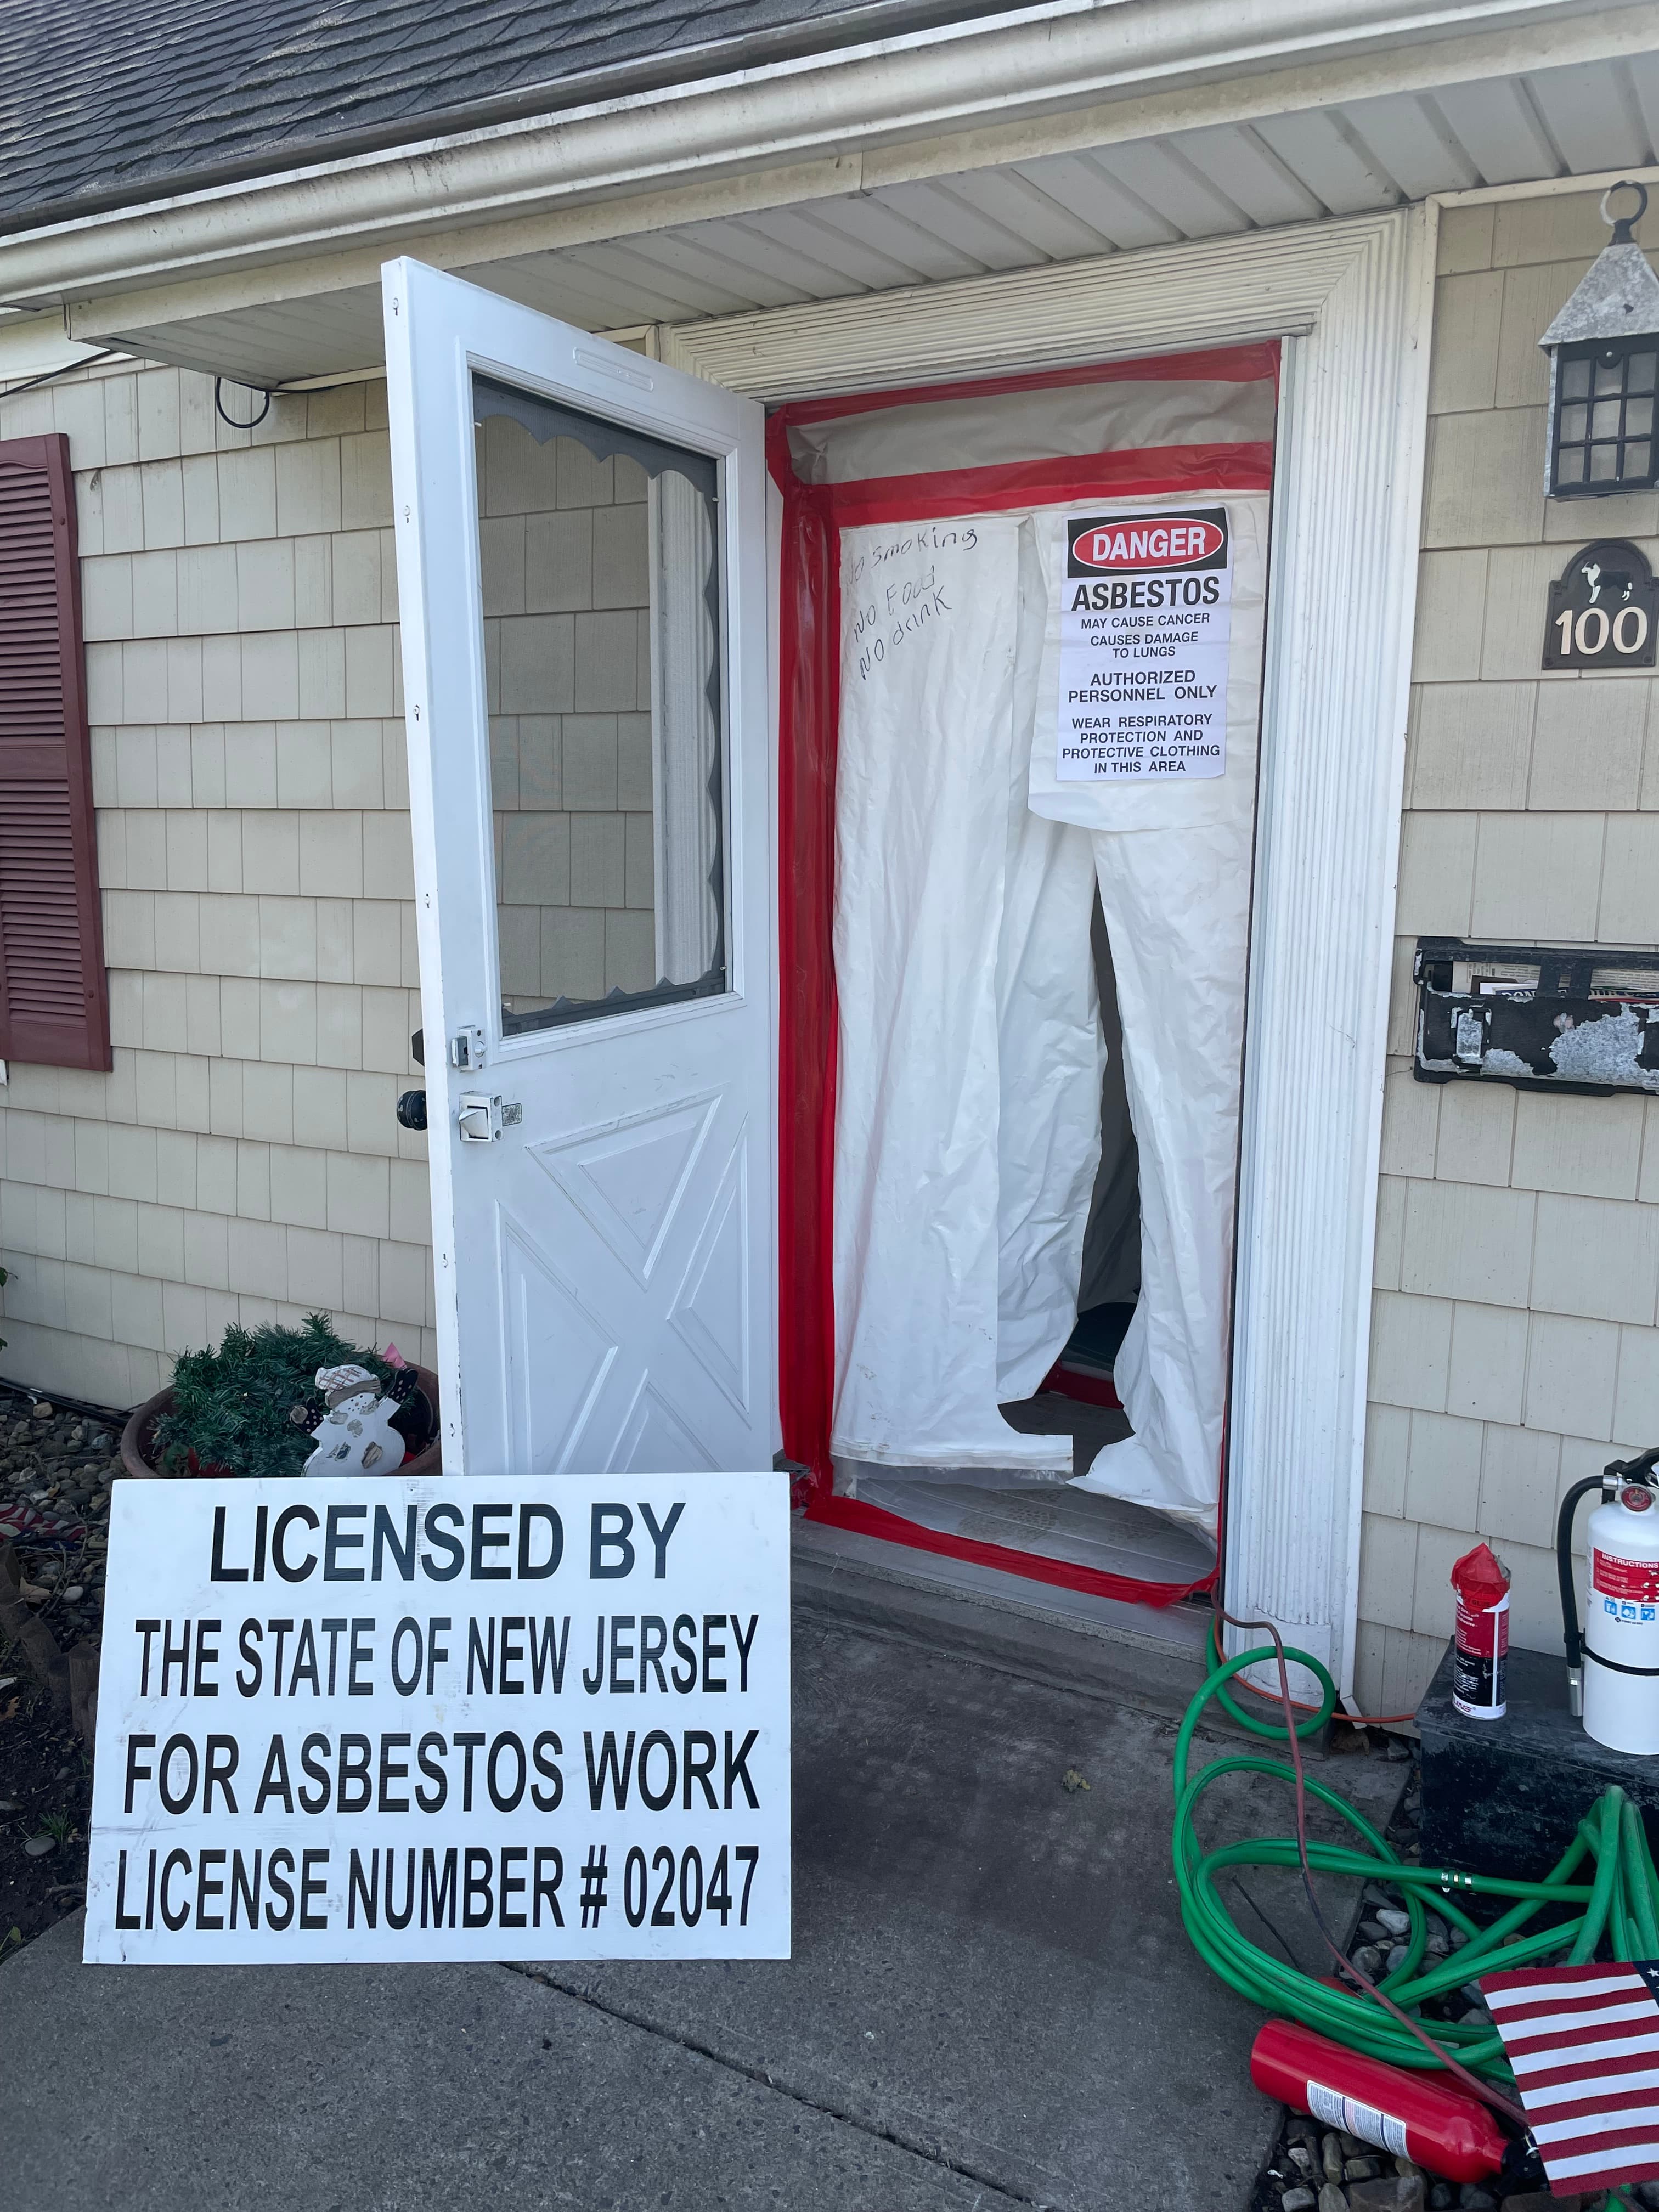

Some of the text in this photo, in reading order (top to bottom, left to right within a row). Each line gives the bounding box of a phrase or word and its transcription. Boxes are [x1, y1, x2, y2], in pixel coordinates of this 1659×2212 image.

[1092, 527, 1206, 561] DANGER
[1071, 576, 1220, 611] ASBESTOS
[1081, 613, 1210, 629] MAY CAUSE CANCER
[1090, 631, 1199, 646] CAUSES DAMAGE
[1555, 606, 1647, 655] 100
[1112, 646, 1176, 658] TO LUNGS
[1090, 670, 1196, 686] AUTHORIZED
[1069, 685, 1217, 703] PERSONNEL ONLY
[1072, 714, 1212, 729] WEAR RESPIRATORY
[1080, 730, 1203, 744] PROTECTION AND
[1063, 745, 1220, 759] PROTECTIVE CLOTHING
[1094, 760, 1186, 774] IN THIS AREA
[211, 1503, 686, 1582] LICENSED BY
[1601, 1553, 1658, 1568] INSTRUCTIONS
[136, 1614, 759, 1697] THE STATE OF NEW JERSEY
[125, 1730, 760, 1814] FOR ASBESTOS WORK
[116, 1845, 758, 1931] LICENSE NUMBER # 02047
